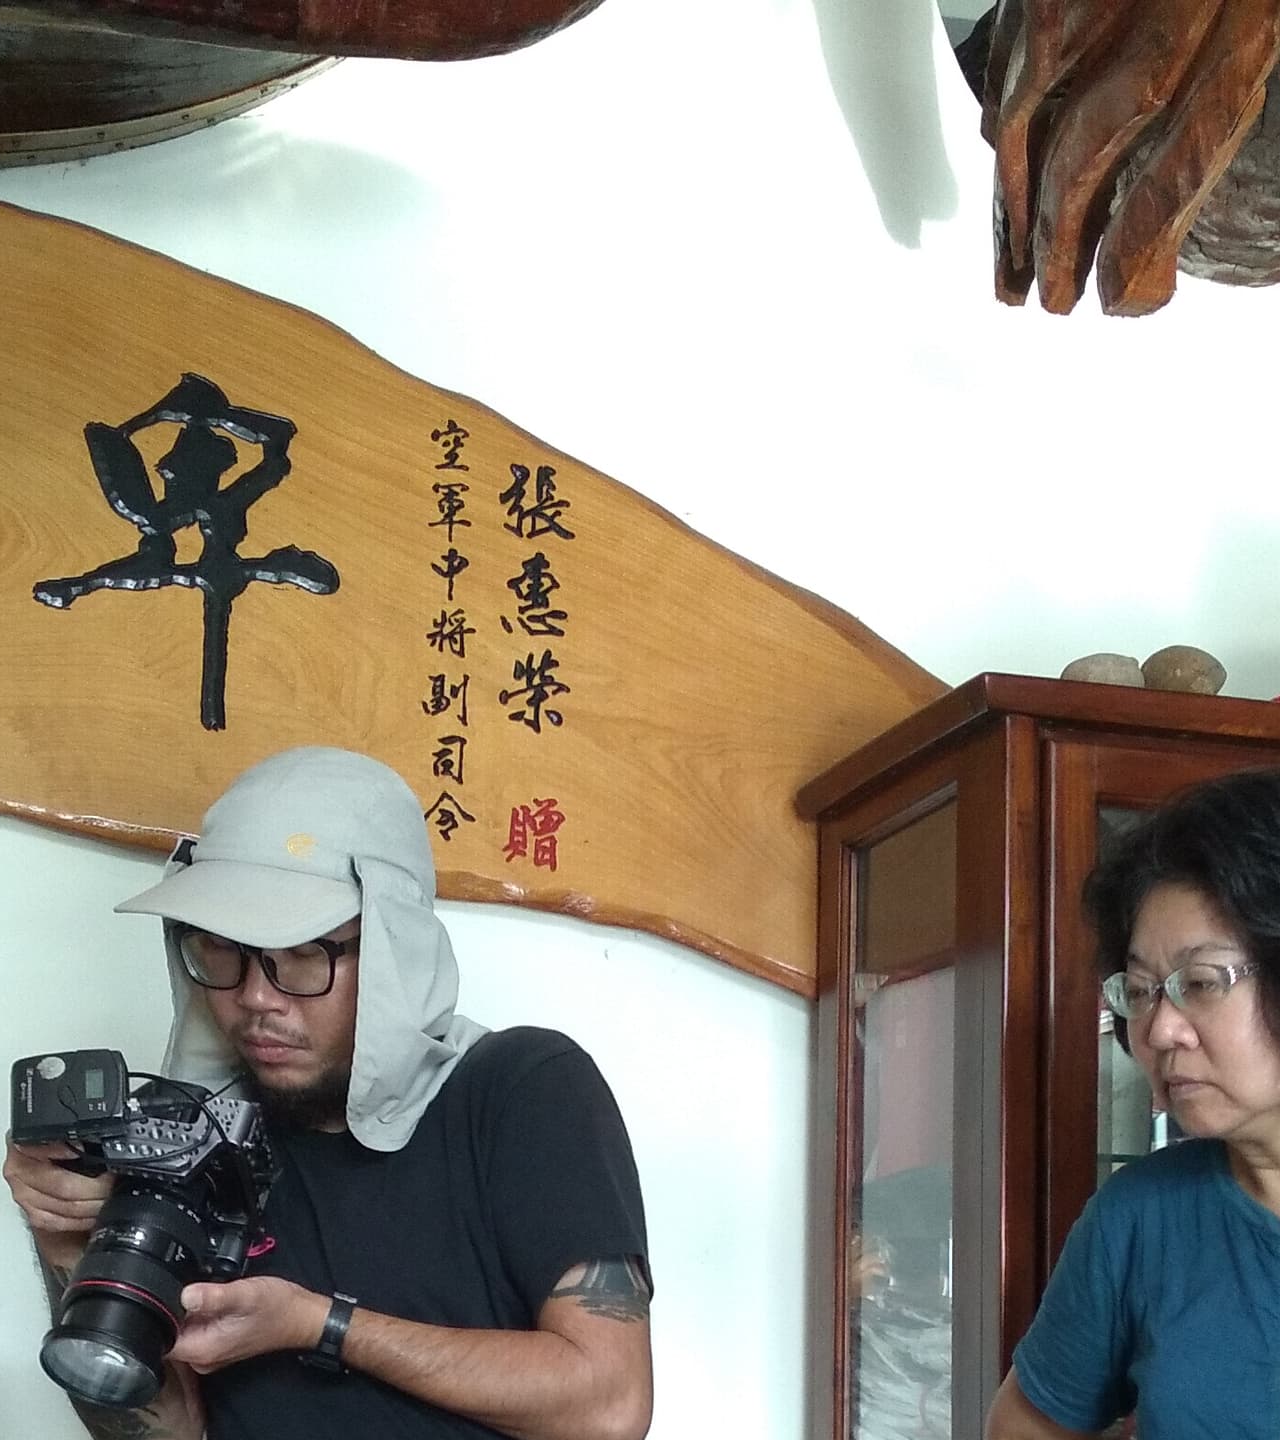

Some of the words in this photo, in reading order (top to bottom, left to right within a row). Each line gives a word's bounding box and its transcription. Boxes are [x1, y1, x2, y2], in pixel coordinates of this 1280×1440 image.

[421, 420, 476, 841] 空軍中將副司令
[499, 464, 575, 733] 張惠榮
[502, 798, 566, 873] 贈
